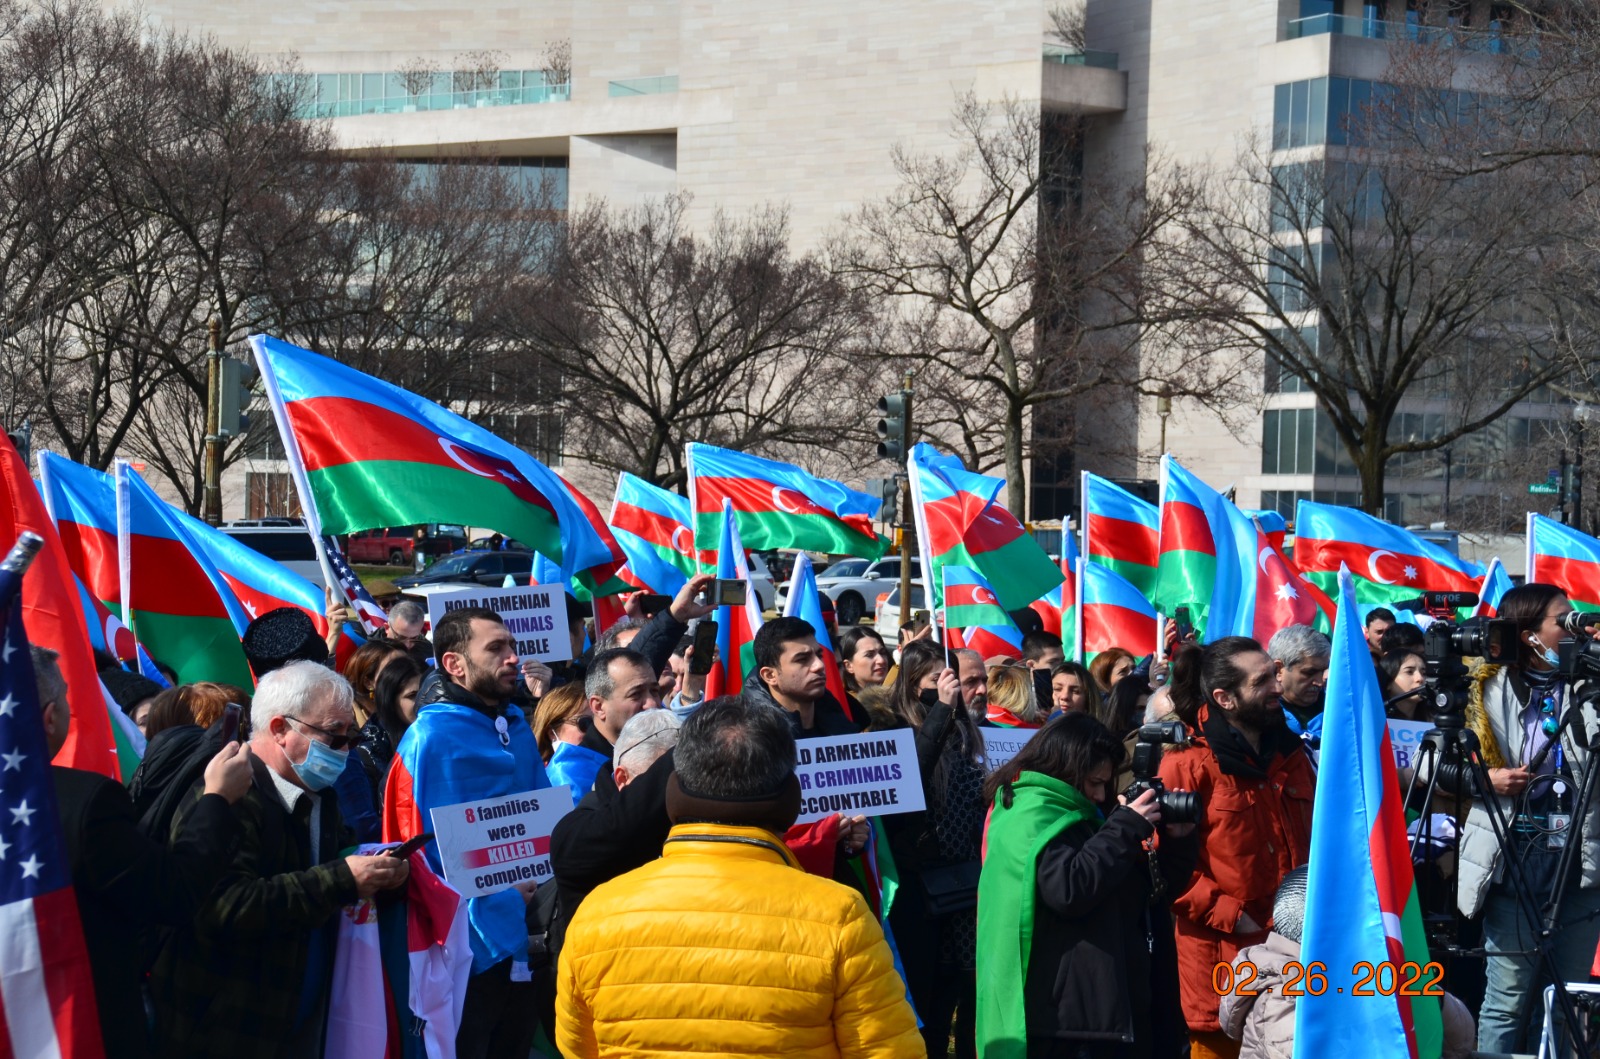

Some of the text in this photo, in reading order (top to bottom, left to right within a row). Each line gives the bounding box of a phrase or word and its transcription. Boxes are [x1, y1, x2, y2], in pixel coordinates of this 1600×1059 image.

[482, 593, 550, 612] ARMENIAN
[503, 615, 554, 633] MINALS
[815, 740, 898, 764] ARMENIAN
[814, 763, 902, 789] CRIMINALS
[464, 798, 540, 824] 8 families
[799, 788, 899, 815] CCOUNTABLE
[487, 822, 526, 841] were
[487, 841, 535, 865] KILLED
[474, 859, 552, 889] completel
